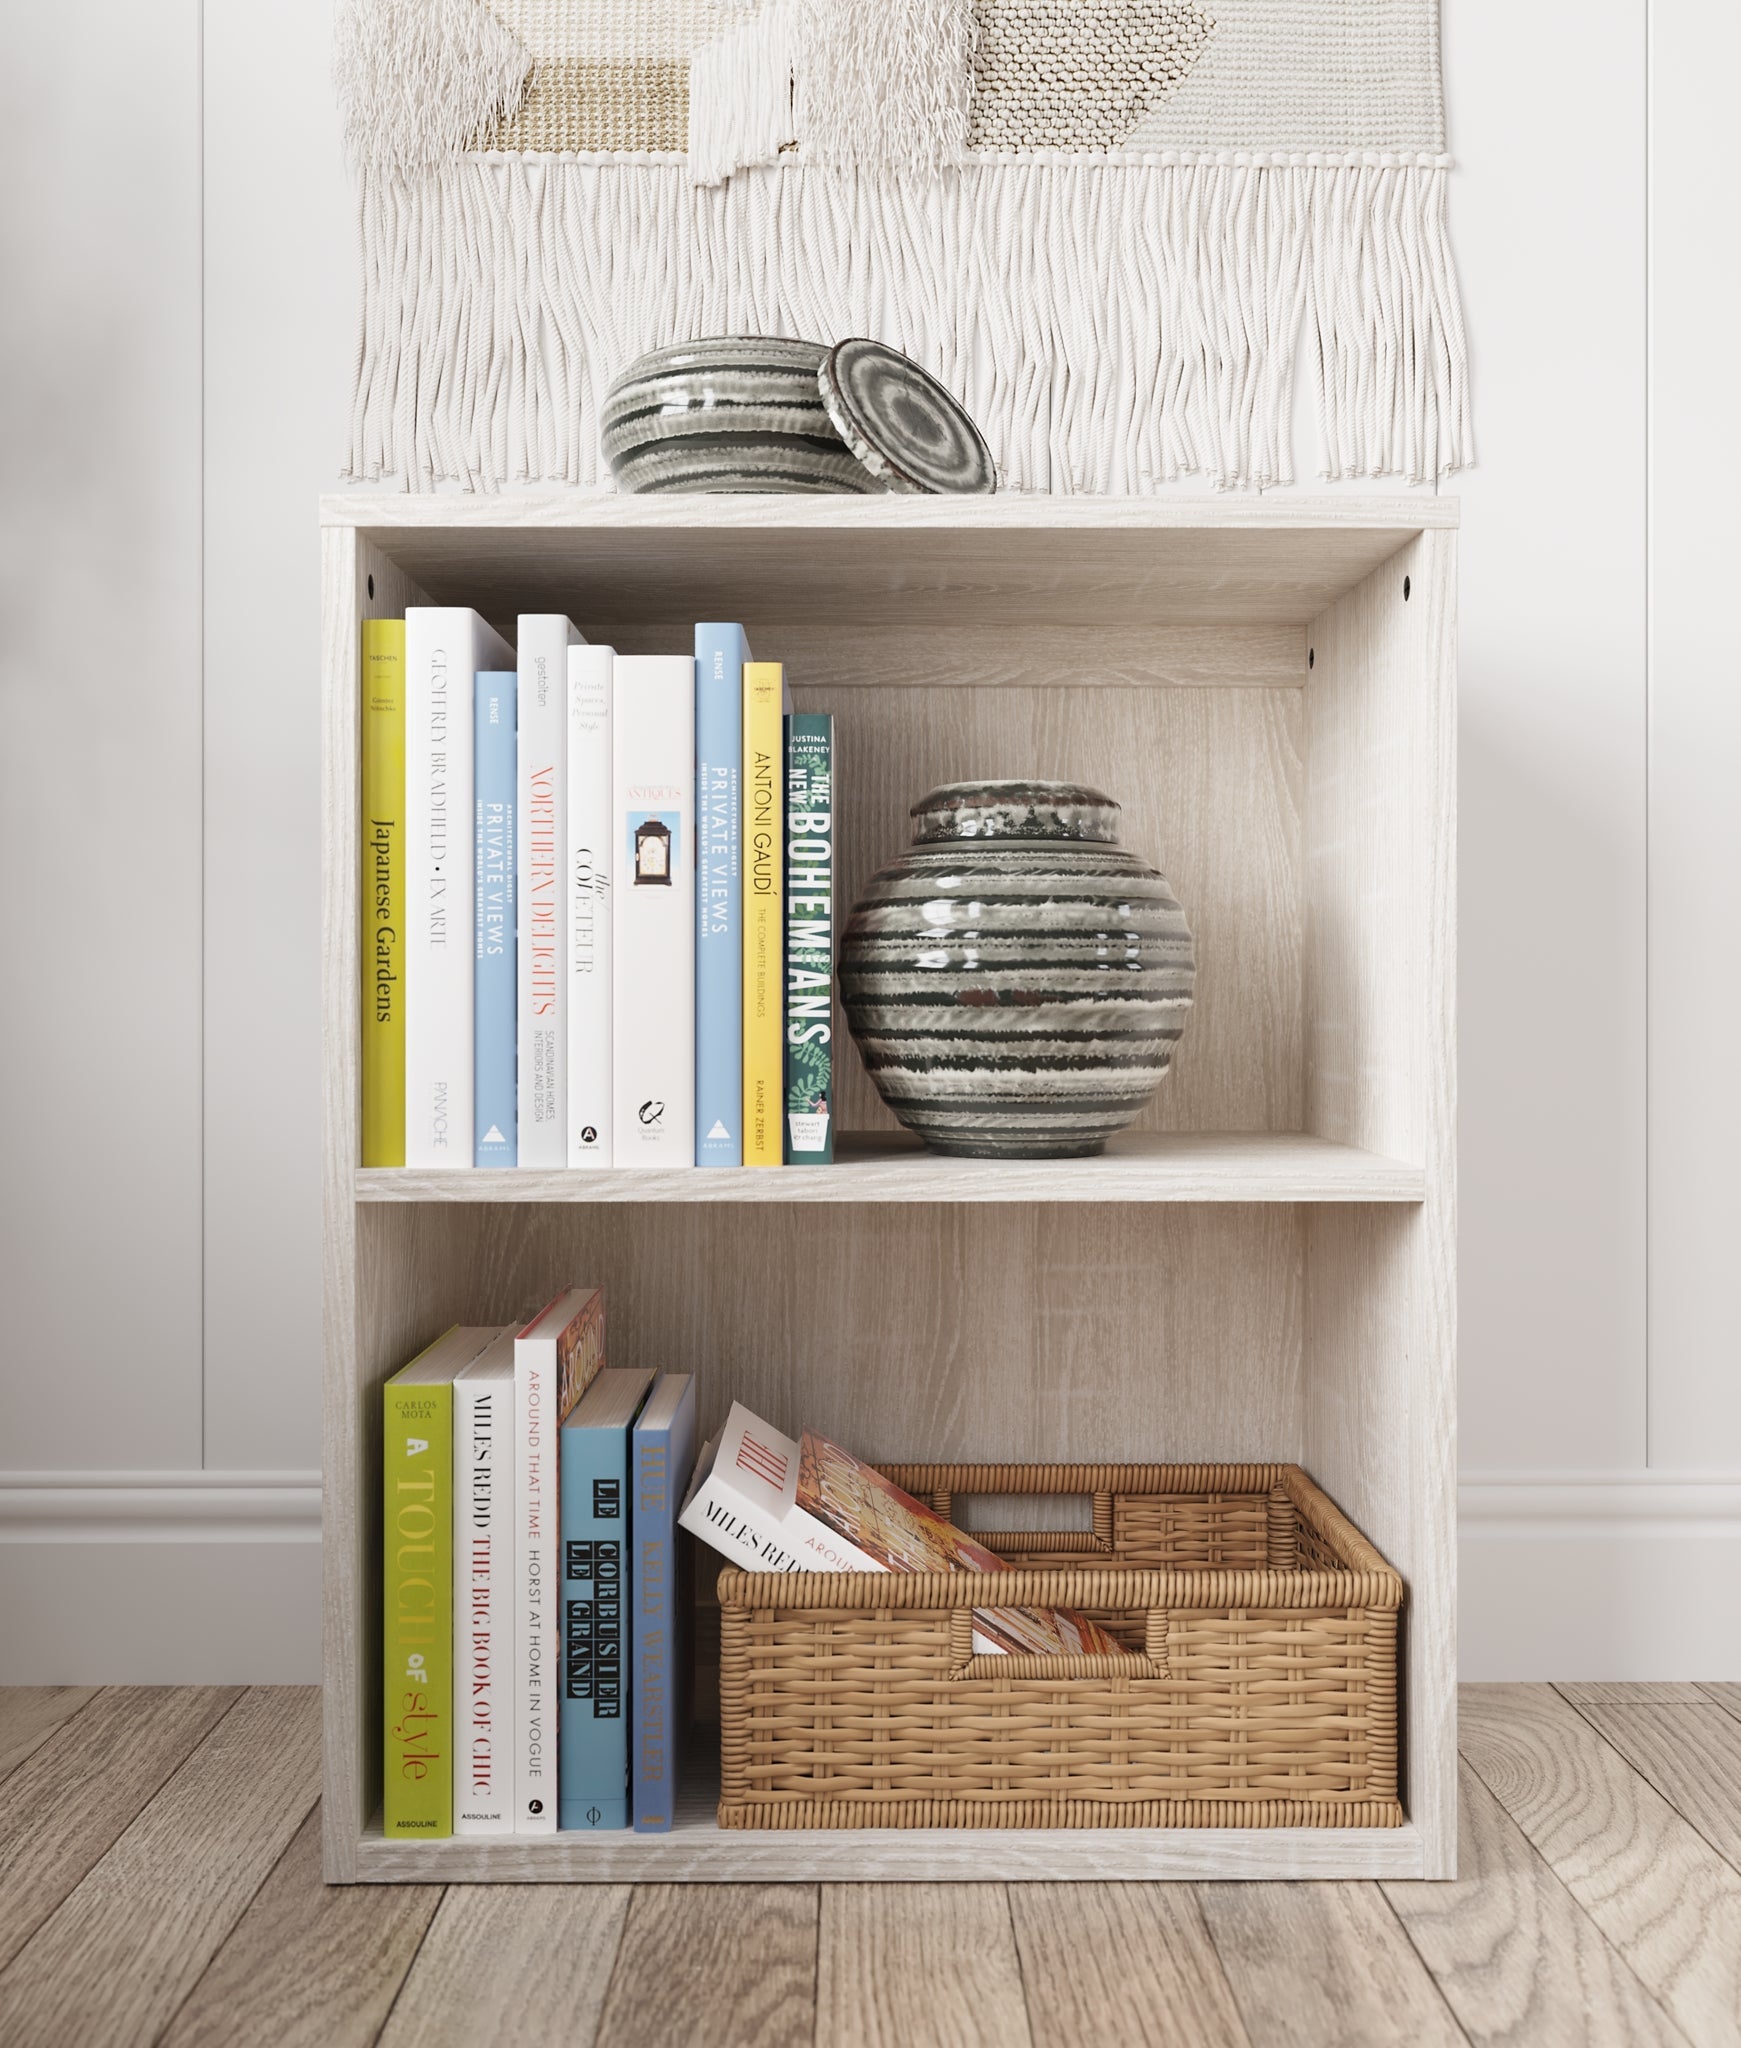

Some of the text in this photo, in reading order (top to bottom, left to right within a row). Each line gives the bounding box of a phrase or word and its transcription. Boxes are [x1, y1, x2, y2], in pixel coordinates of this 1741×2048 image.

[489, 697, 499, 724] RENSE
[534, 656, 549, 707] gestalten
[574, 681, 604, 690] Private
[713, 651, 723, 680] RENSE
[572, 708, 608, 717] Personal
[788, 745, 830, 753] BLAKENEY
[792, 735, 827, 743] JUSTINA
[430, 649, 448, 951] GEOFFREY BRADFIELD EX ARTE
[626, 788, 681, 800] ANTIQUES
[753, 752, 777, 896] ANTONI GAUDÍ
[788, 768, 808, 804] NEW
[811, 773, 830, 804] THE
[476, 799, 484, 959] INSIDE THE WORLD'S GREATEST HOMES
[486, 803, 504, 955] PRIVATE VIEWS
[530, 766, 556, 1015] NORTHERN DELIGHTS
[594, 873, 610, 900] the
[700, 763, 708, 938] INSIDE THE WORLD'S GREATEST HOMES
[711, 767, 728, 934] PRIVATE VIEWS
[370, 819, 397, 1023] Japanese Gardens
[574, 848, 594, 973] COVETEUR
[787, 812, 831, 1045] BOHEMIANS
[756, 908, 766, 1018] THE COMPLETE BUILDINGS
[533, 1030, 544, 1122] INTERIORS AND DESIGN
[544, 1030, 555, 1089] SCANDINAVIAN
[432, 1081, 447, 1148] PANACHE
[755, 1079, 765, 1151] RAINER ZERBST
[395, 1400, 437, 1409] CARLOS
[560, 1313, 605, 1417] AROUND
[401, 1410, 432, 1418] MOTA
[597, 1482, 618, 1516] LE
[701, 1500, 763, 1550] MILES
[820, 1442, 862, 1543] AROUND
[391, 1438, 440, 1780] A TOUCH OF style
[472, 1393, 492, 1796] MILES REDD THE BIG BOOK OF CHIC
[528, 1370, 541, 1777] AROUND THAT TIME HORST AT HOME IN VOGUE
[641, 1444, 666, 1783] HUE KELLY WEARSTLER
[571, 1544, 591, 1697] LE GRAND
[597, 1543, 618, 1717] CORBUSIER
[396, 1820, 438, 1828] ASSOULINE
